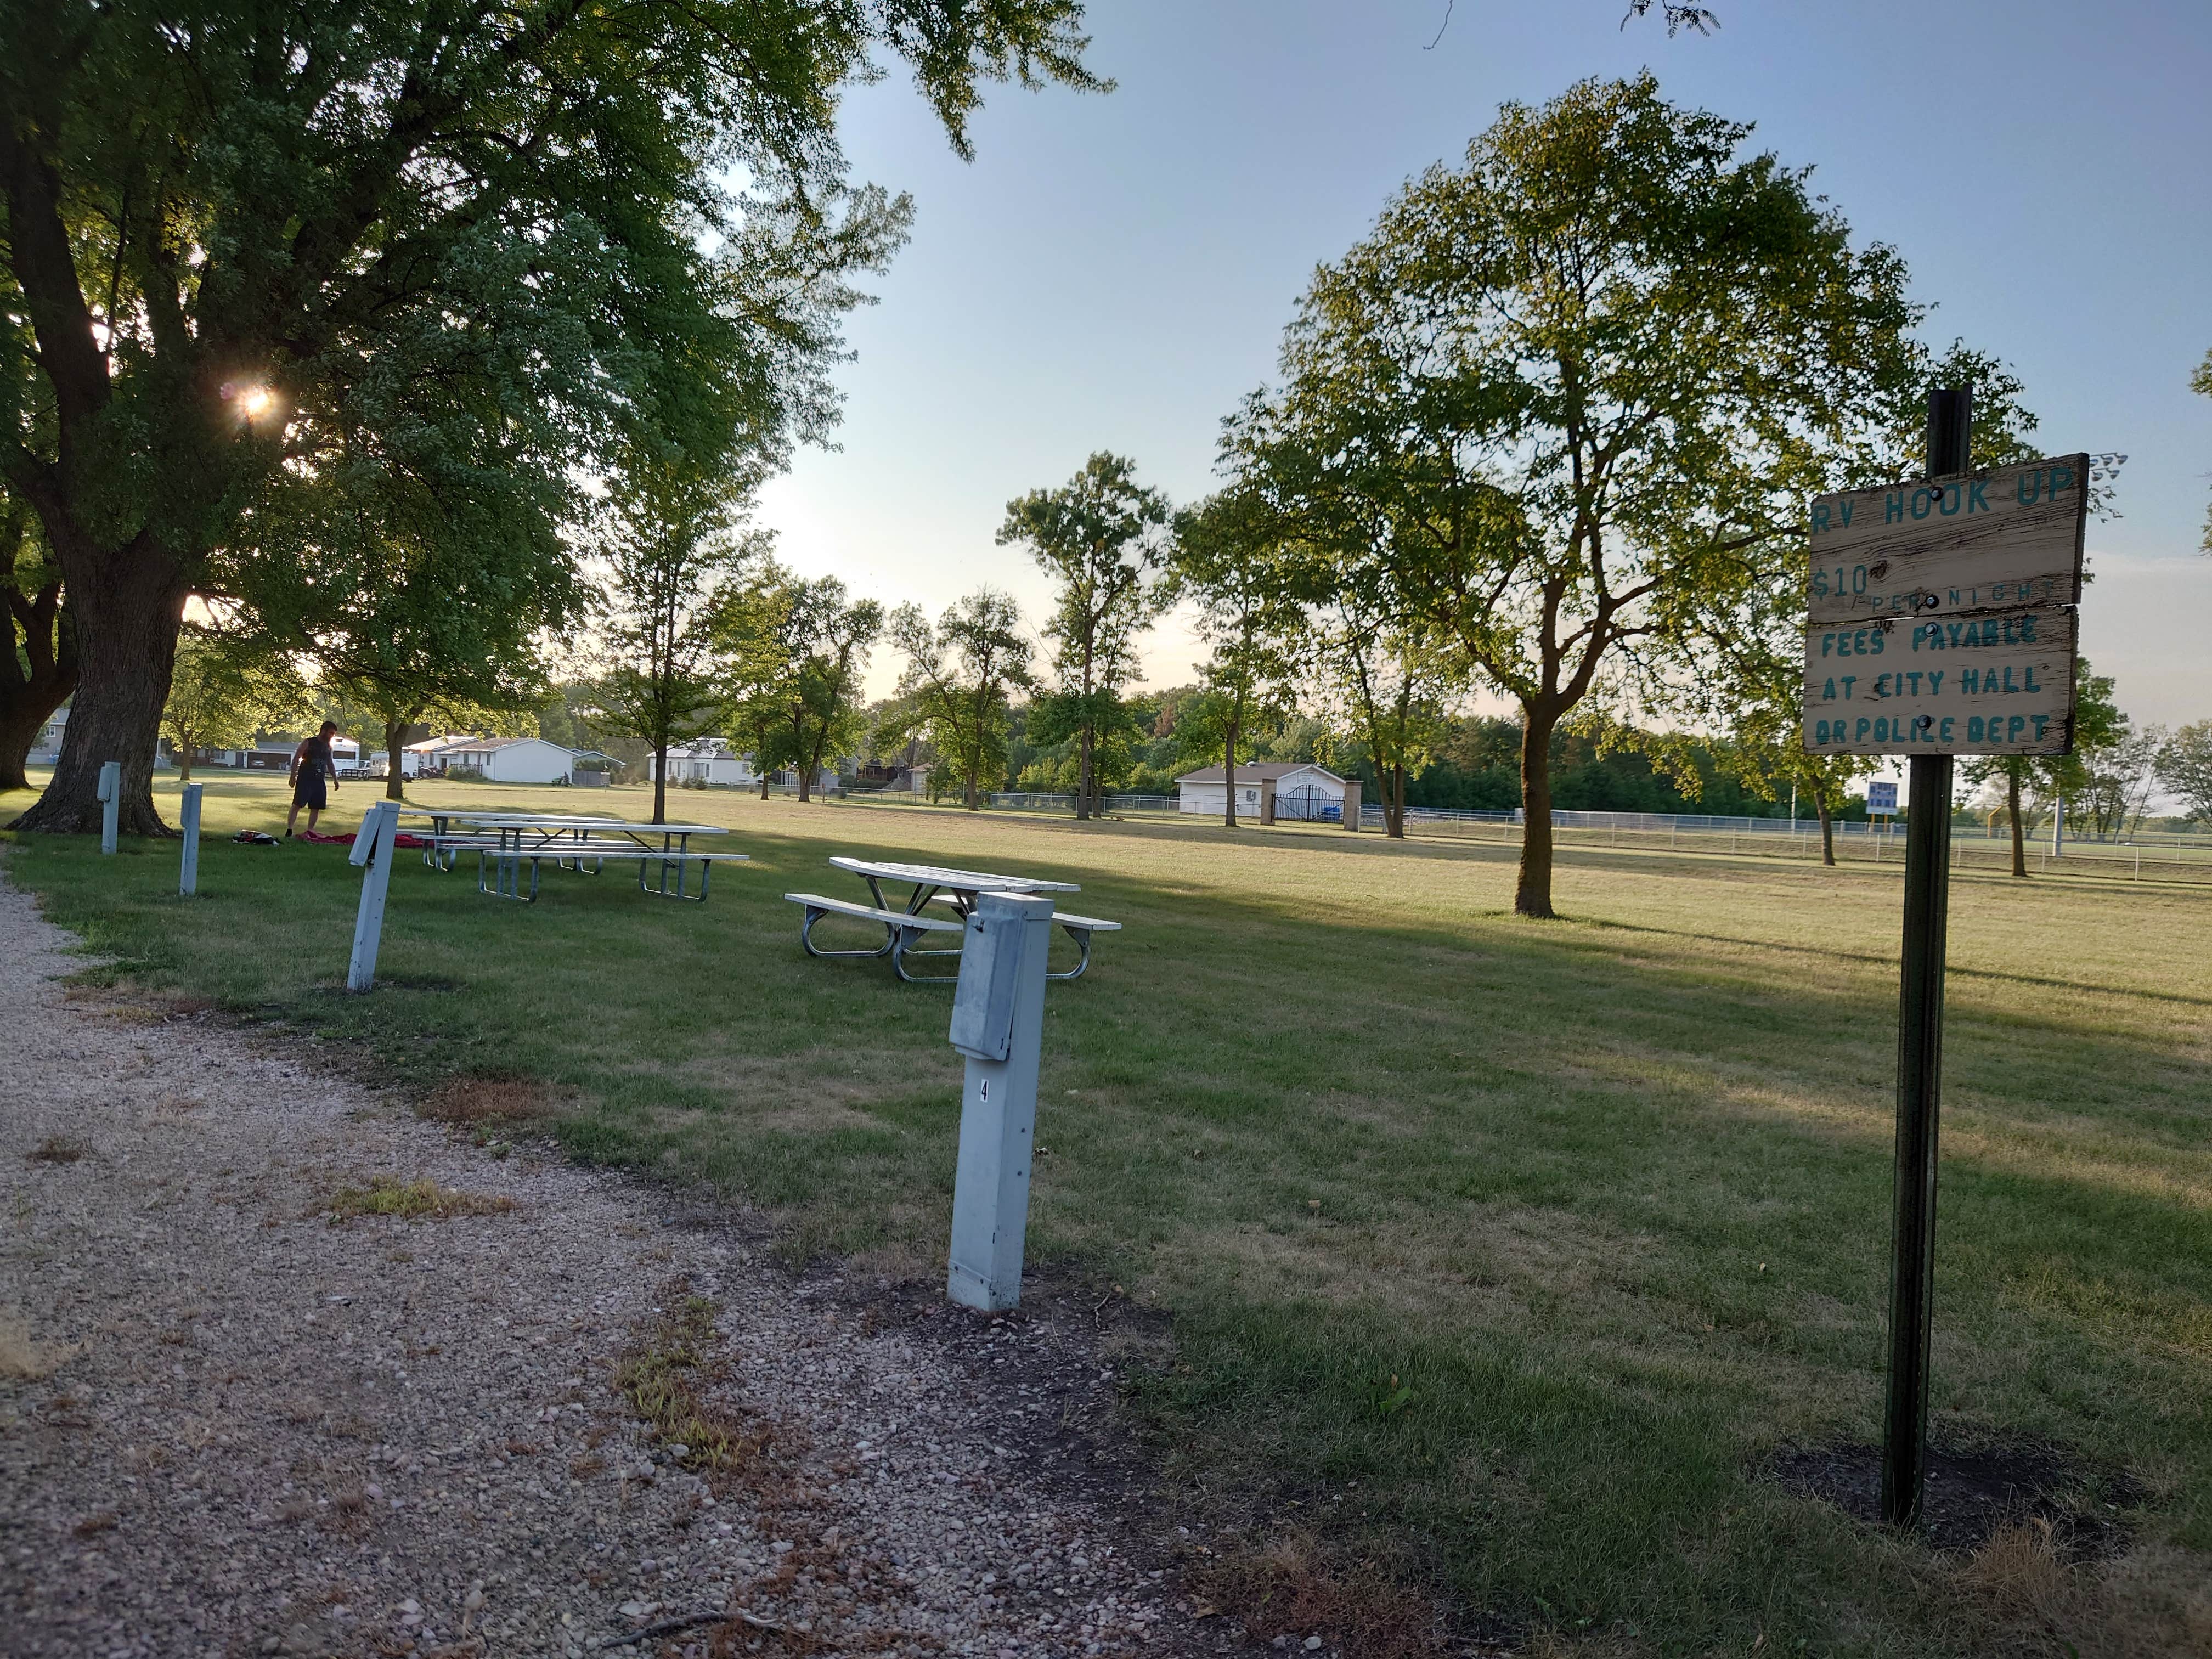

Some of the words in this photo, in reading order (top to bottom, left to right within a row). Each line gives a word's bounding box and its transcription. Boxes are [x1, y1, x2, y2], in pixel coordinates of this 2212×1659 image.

[1812, 499, 1854, 534] RV
[1885, 479, 1990, 524] HOOK
[2017, 467, 2073, 505] UP
[1813, 565, 1867, 601] $10
[1871, 594, 1919, 613] PER
[1948, 580, 2053, 606] NIGHT
[1822, 629, 1884, 657] FEES
[1912, 615, 2038, 652] PAYABLE
[1822, 676, 1857, 700] AT
[1875, 670, 1945, 698] CITY
[1962, 666, 2041, 695] HALL
[1815, 719, 1848, 744] OR
[1855, 716, 1955, 743] POLICE
[1967, 715, 2050, 743] DEPT
[981, 1080, 988, 1101] 4
